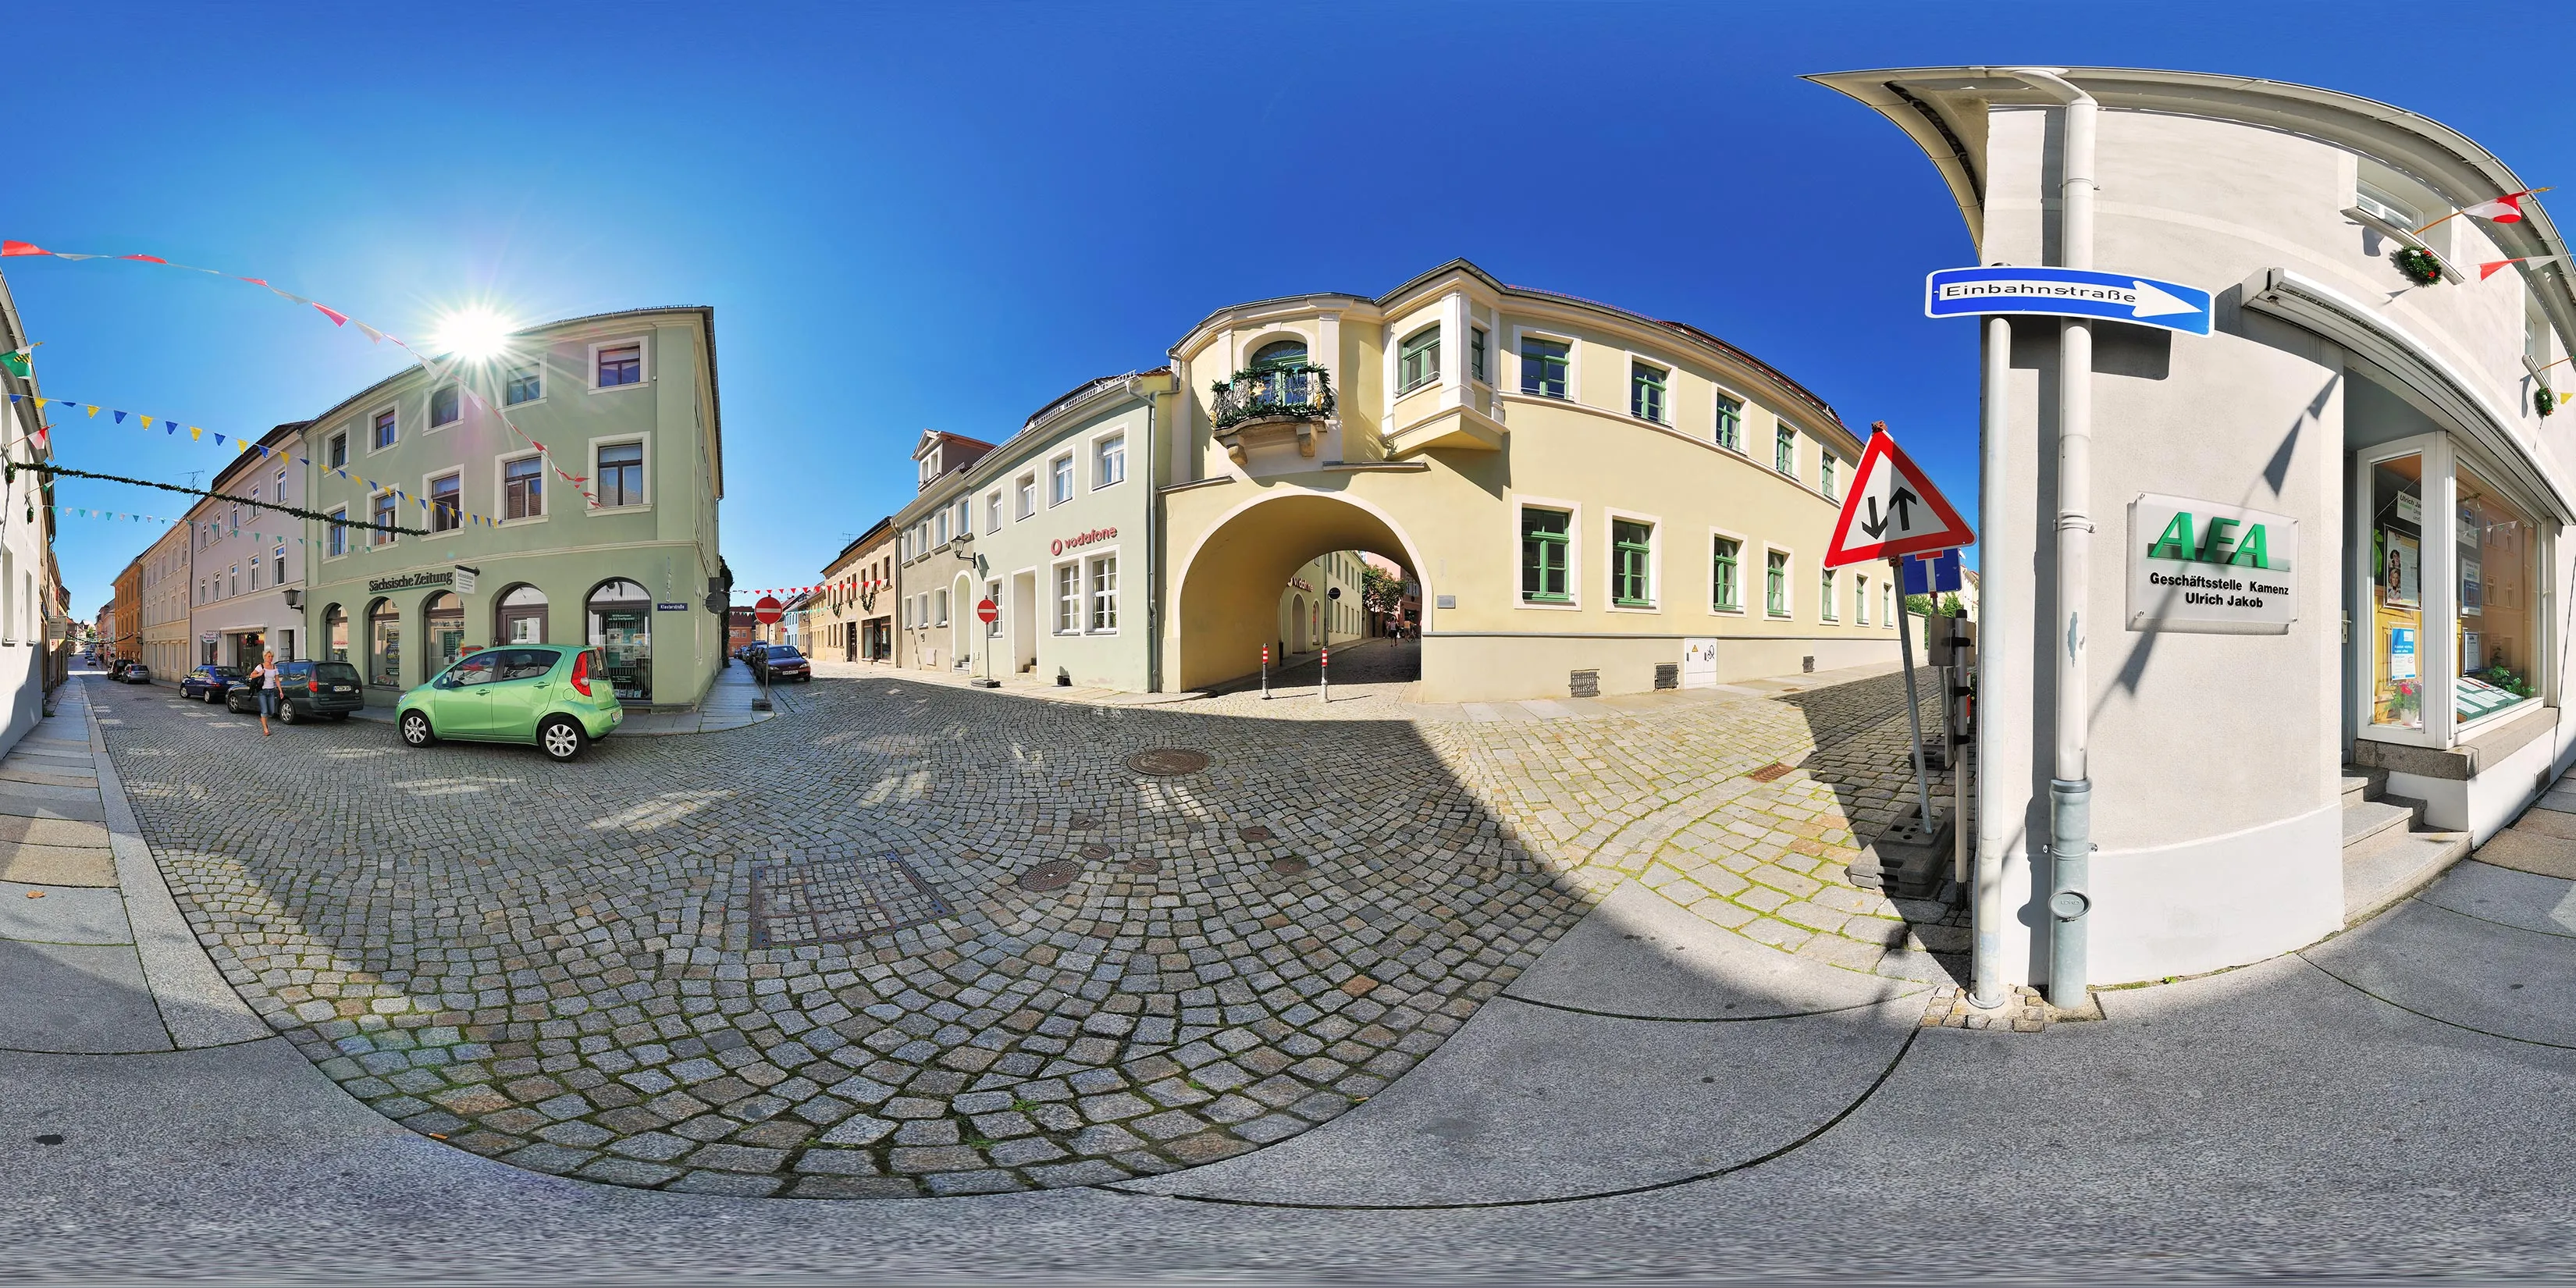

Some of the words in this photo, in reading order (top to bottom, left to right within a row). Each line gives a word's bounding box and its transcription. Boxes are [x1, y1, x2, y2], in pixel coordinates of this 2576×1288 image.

[1946, 283, 2137, 303] Einbahnstraße
[2400, 494, 2414, 506] Ulrich
[1064, 526, 1118, 549] vodafone
[2148, 511, 2269, 569] AFA
[368, 575, 414, 592] Sächsische
[414, 572, 453, 585] Zeitung
[2150, 571, 2243, 591] Geschäftsstelle
[2250, 581, 2289, 595] Kamenz
[2185, 592, 2224, 606] Ulrich
[2227, 595, 2263, 608] Jakob
